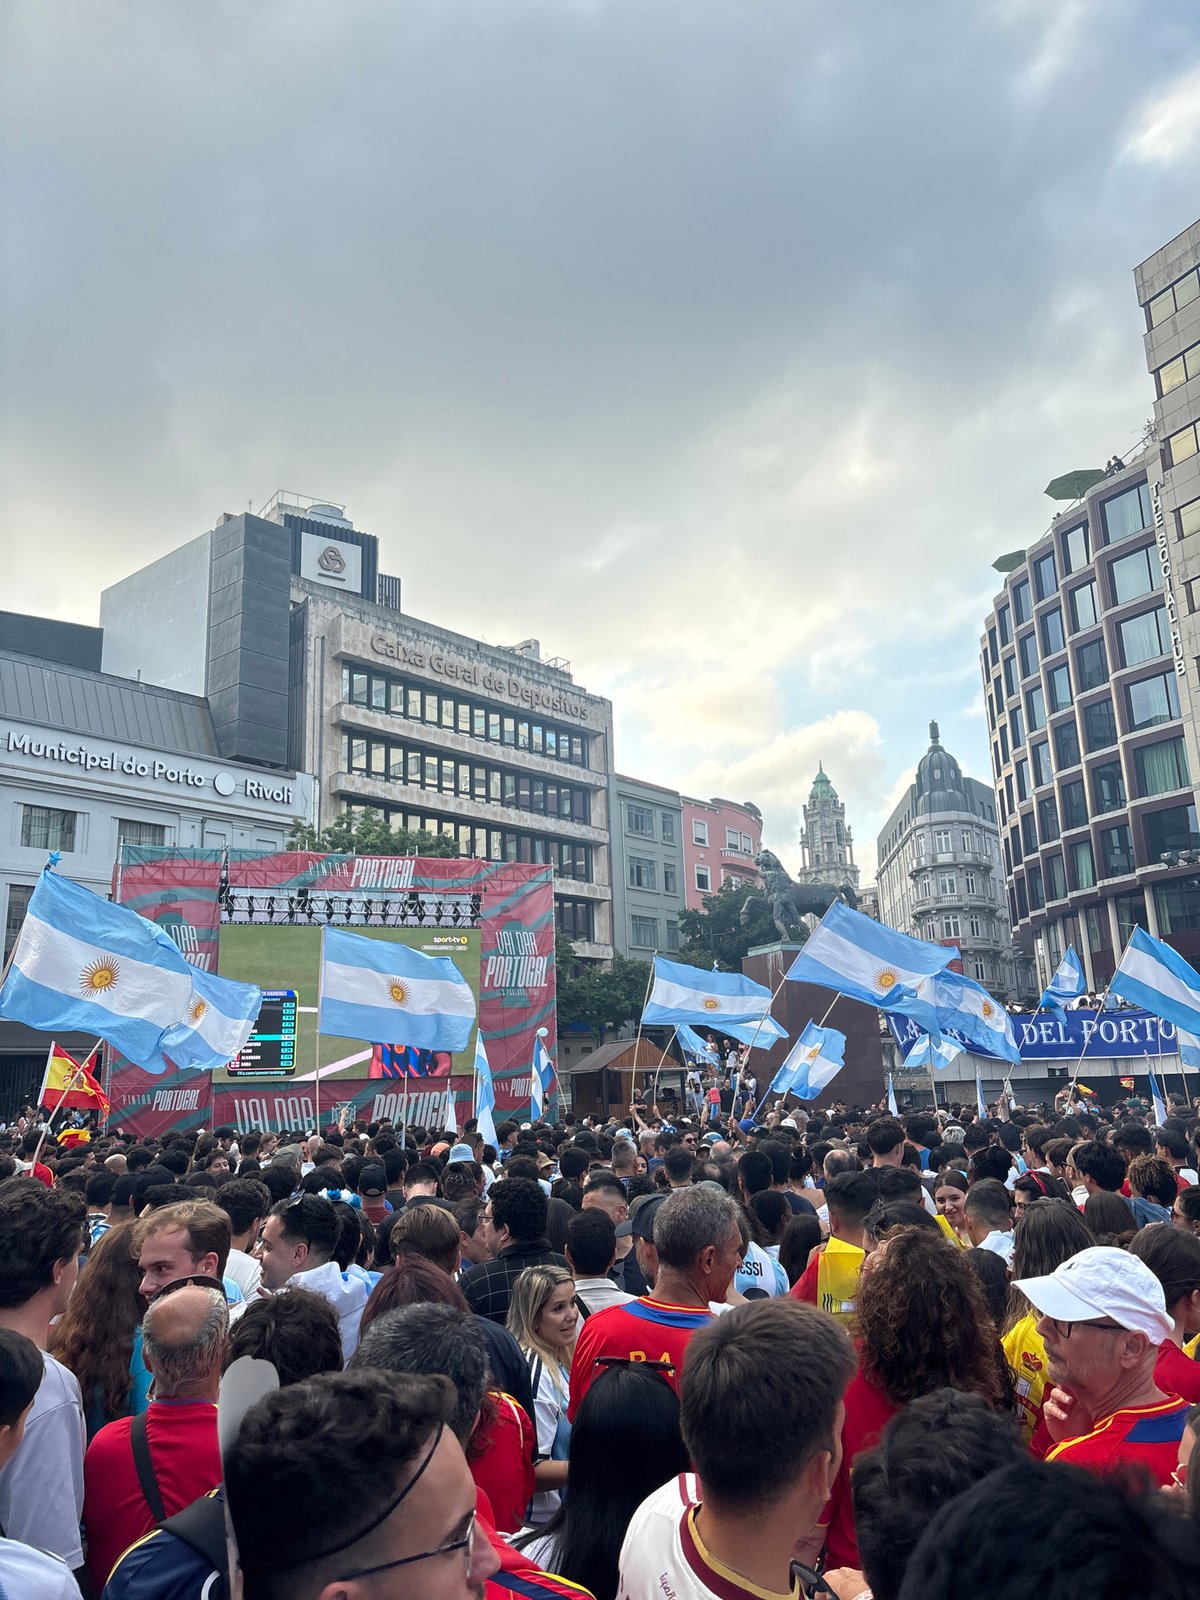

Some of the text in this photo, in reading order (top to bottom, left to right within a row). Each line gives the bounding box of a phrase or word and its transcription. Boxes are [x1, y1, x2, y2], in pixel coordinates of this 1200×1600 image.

[1150, 481, 1186, 676] THE SOCIAL HUB
[371, 634, 426, 668] Caixa
[429, 653, 480, 686] Geral
[482, 670, 506, 693] de
[7, 731, 293, 804] Municipal do Porto Rivoli
[308, 857, 416, 889] PINTAR PORTUGAL
[496, 931, 539, 956] VAI DAR
[484, 955, 548, 988] PORTUGAL
[1020, 1021, 1076, 1046] DEL
[1081, 1017, 1177, 1045] PORTO
[152, 1089, 201, 1111] PORTUGAL
